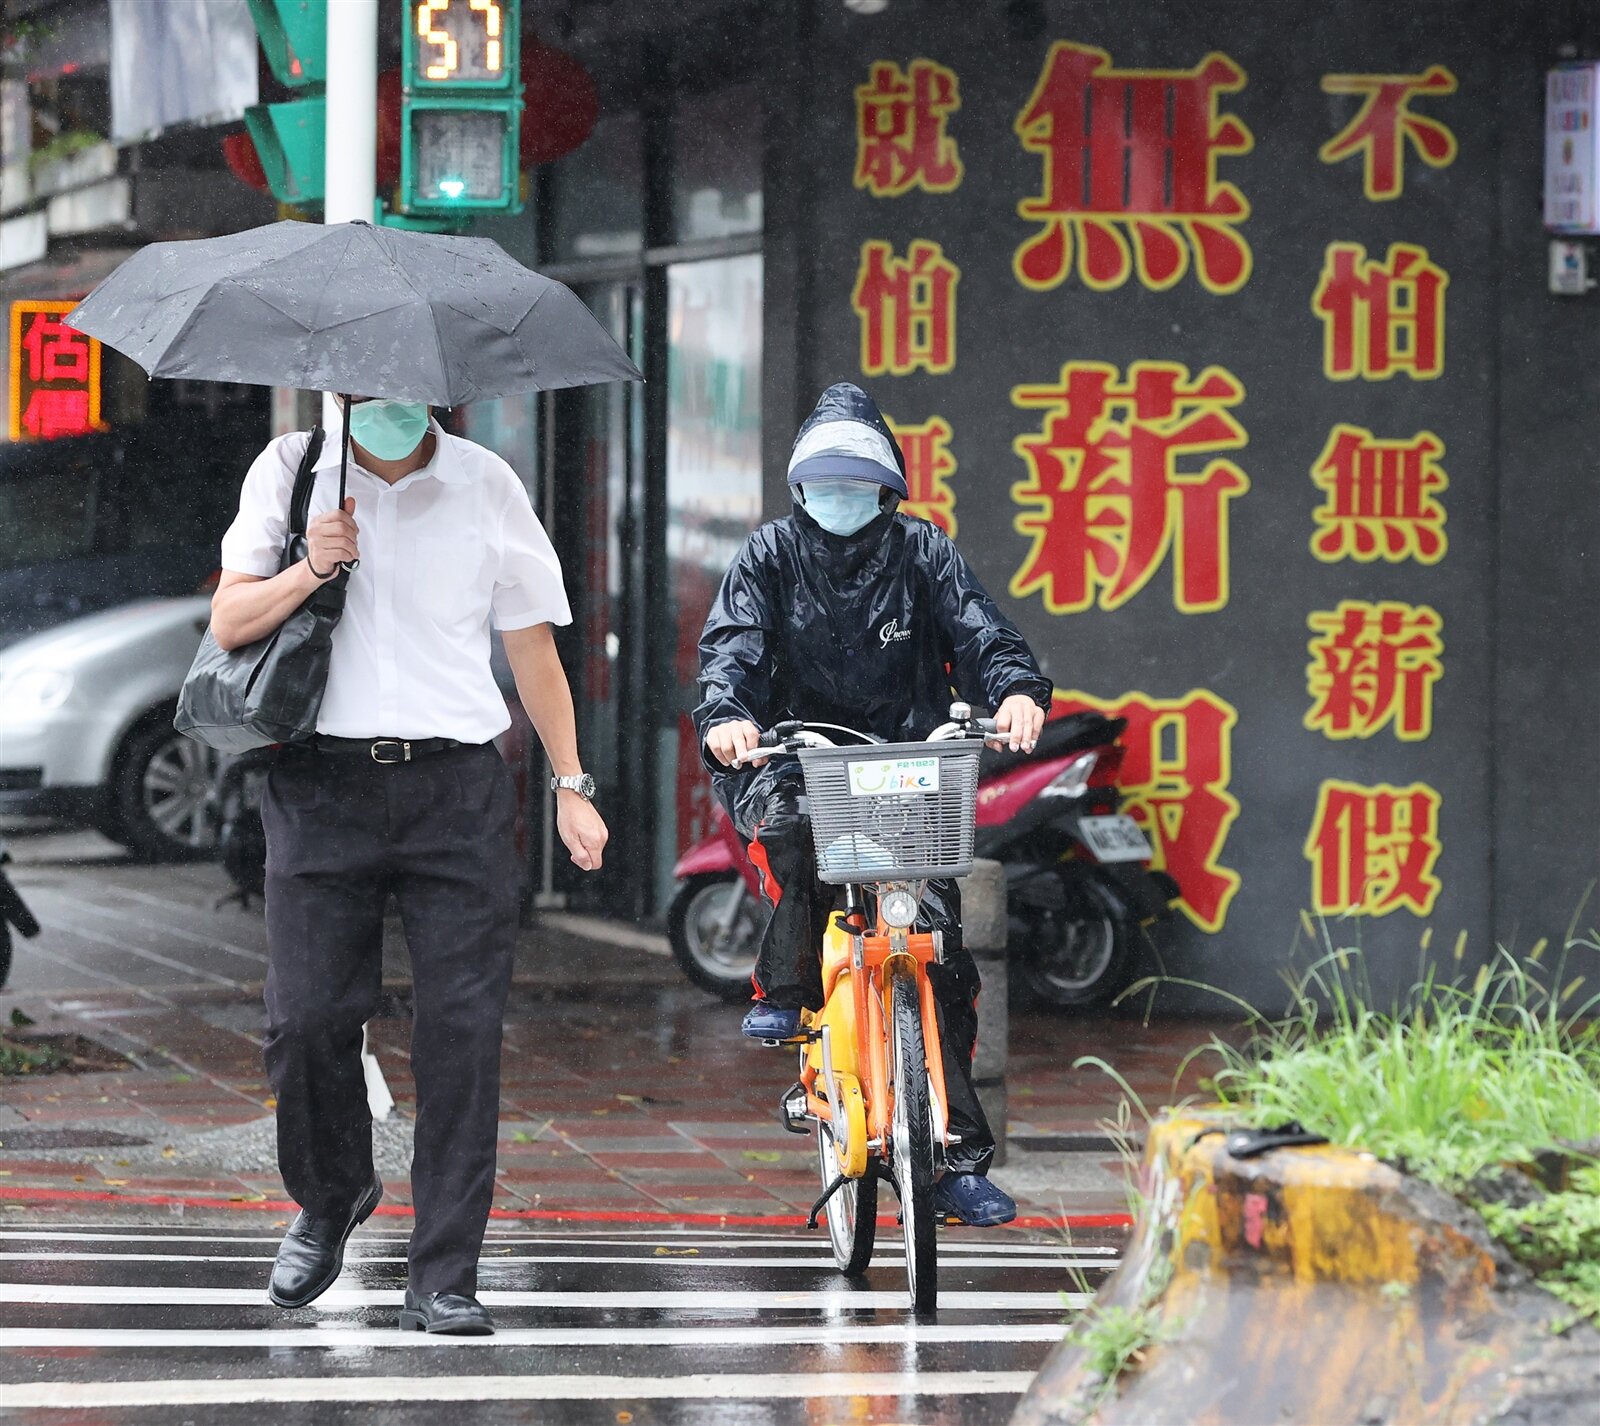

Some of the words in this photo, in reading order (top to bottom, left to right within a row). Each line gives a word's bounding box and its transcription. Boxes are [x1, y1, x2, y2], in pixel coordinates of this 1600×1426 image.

[418, 0, 500, 79] 57
[1303, 64, 1459, 919] 不怕無薪假
